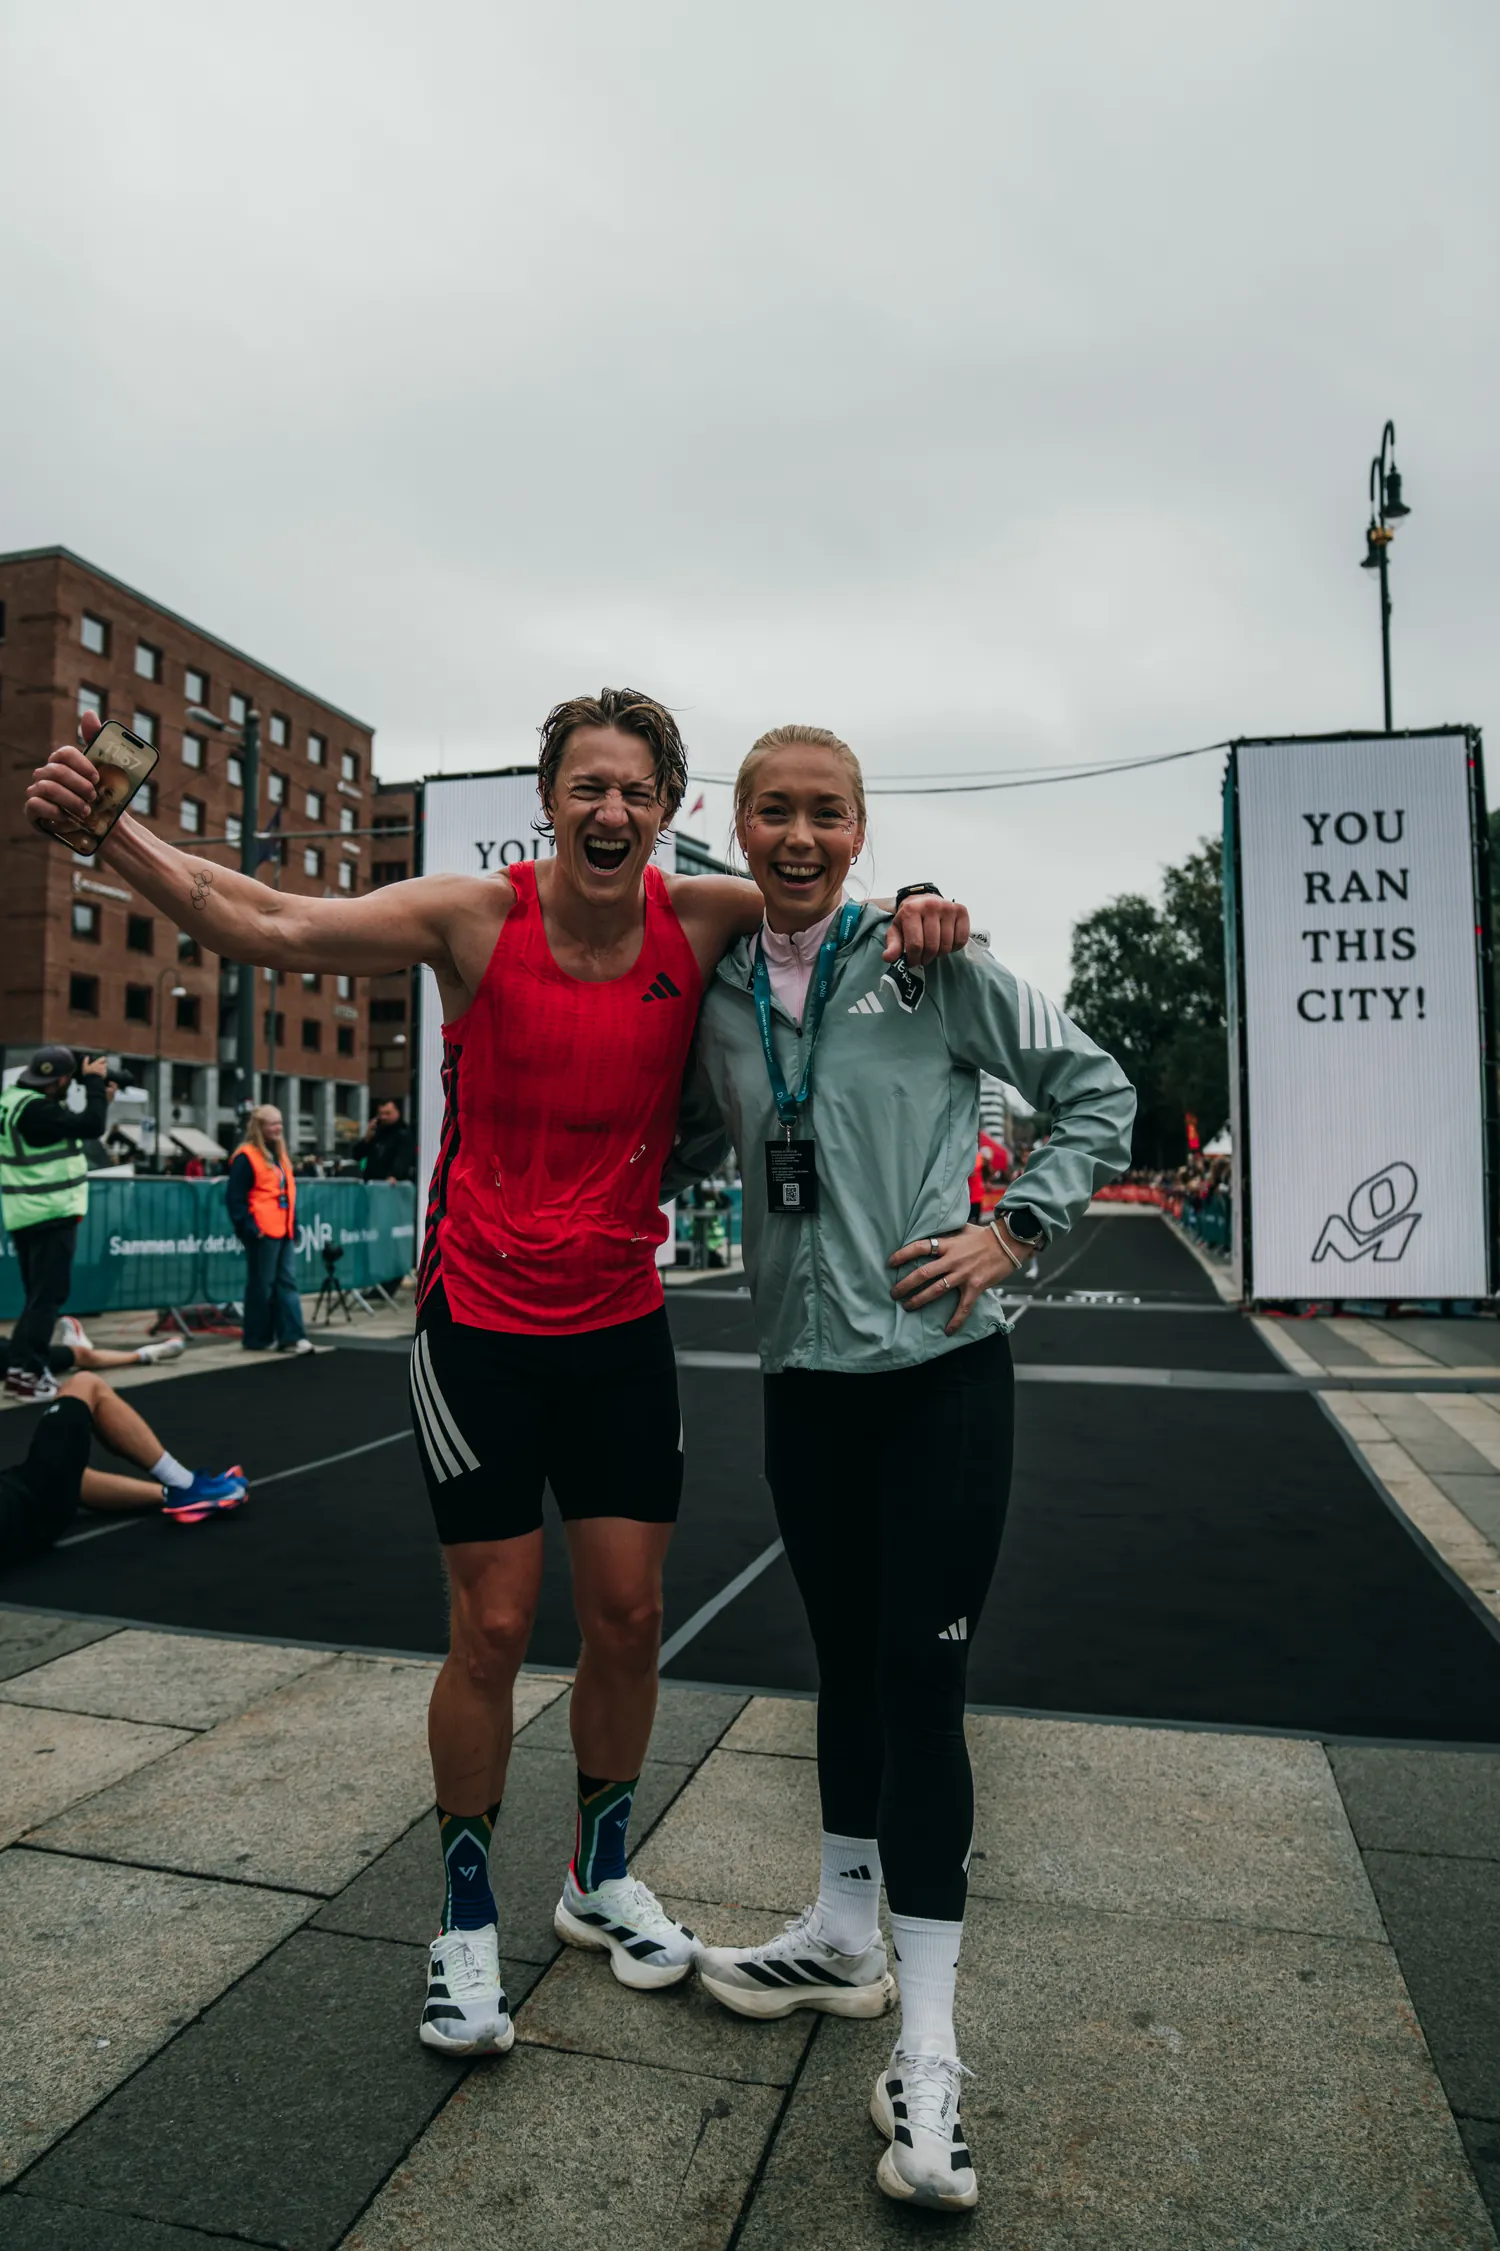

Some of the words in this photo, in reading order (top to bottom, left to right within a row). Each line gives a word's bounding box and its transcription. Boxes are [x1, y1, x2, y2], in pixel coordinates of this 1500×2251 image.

[1302, 809, 1405, 846] YOU
[1304, 868, 1408, 904] RAN
[1302, 927, 1416, 963] THIS
[1297, 985, 1425, 1022] CITY!
[109, 1235, 176, 1256] Sammen
